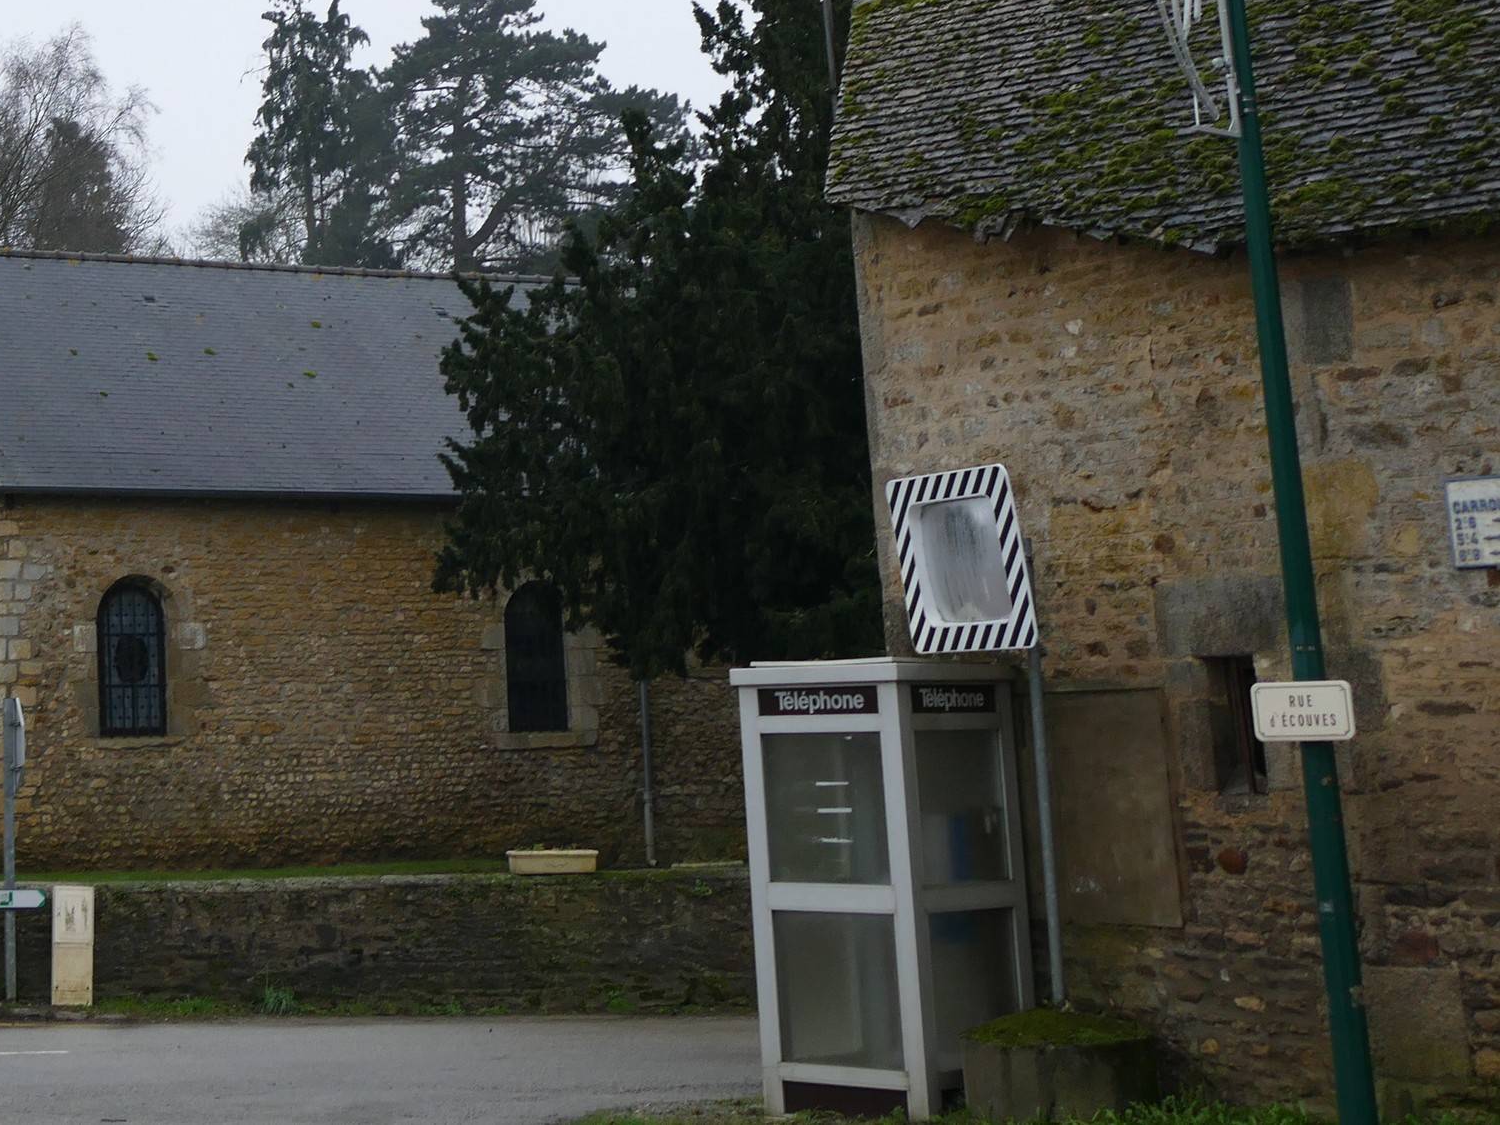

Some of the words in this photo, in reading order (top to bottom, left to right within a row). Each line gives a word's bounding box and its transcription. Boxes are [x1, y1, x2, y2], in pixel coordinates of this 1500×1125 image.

[774, 690, 865, 715] Téléphone
[919, 688, 985, 711] Téléphone
[1289, 694, 1313, 707] RUE
